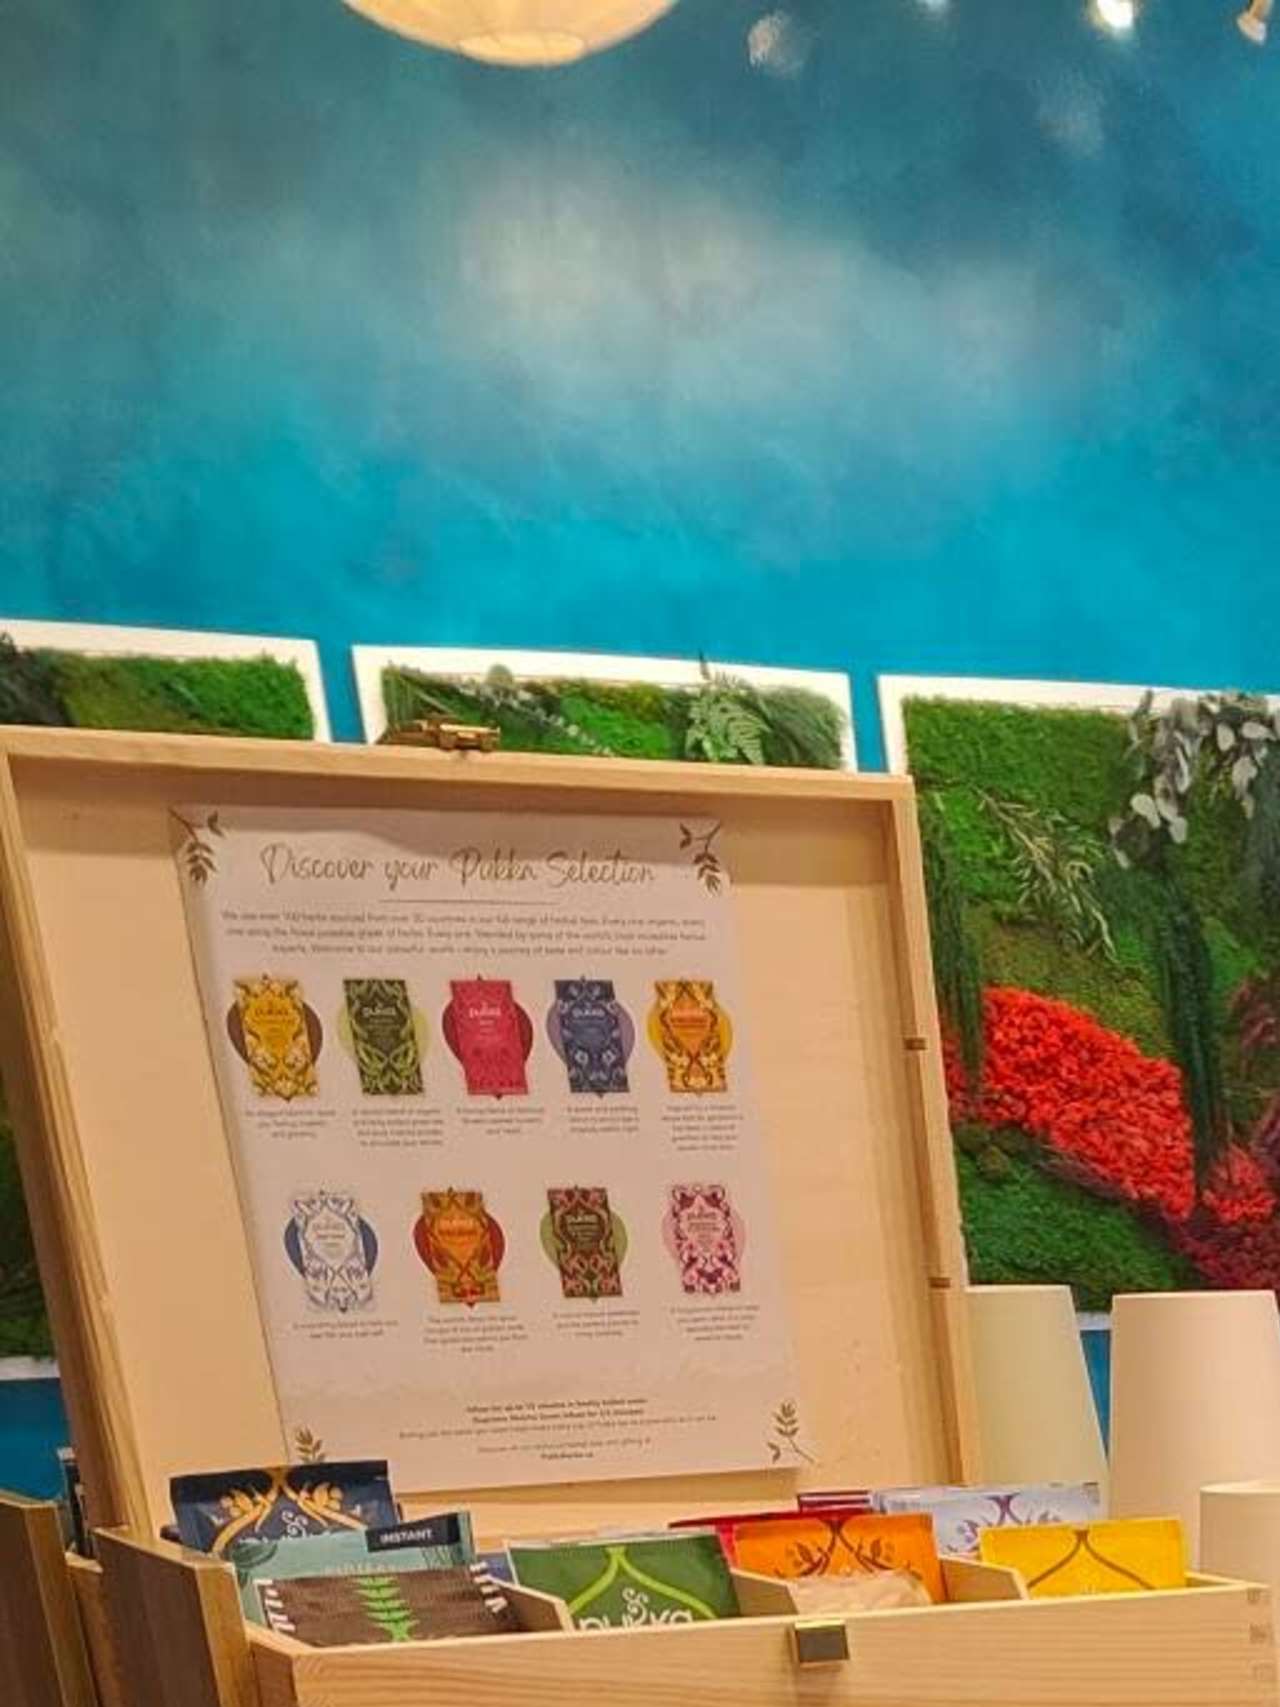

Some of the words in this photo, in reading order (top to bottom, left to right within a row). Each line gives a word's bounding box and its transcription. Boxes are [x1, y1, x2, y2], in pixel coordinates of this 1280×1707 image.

[260, 841, 374, 886] Discover
[385, 858, 438, 892] your
[546, 848, 656, 888] Selection
[379, 1528, 433, 1544] INSTANT
